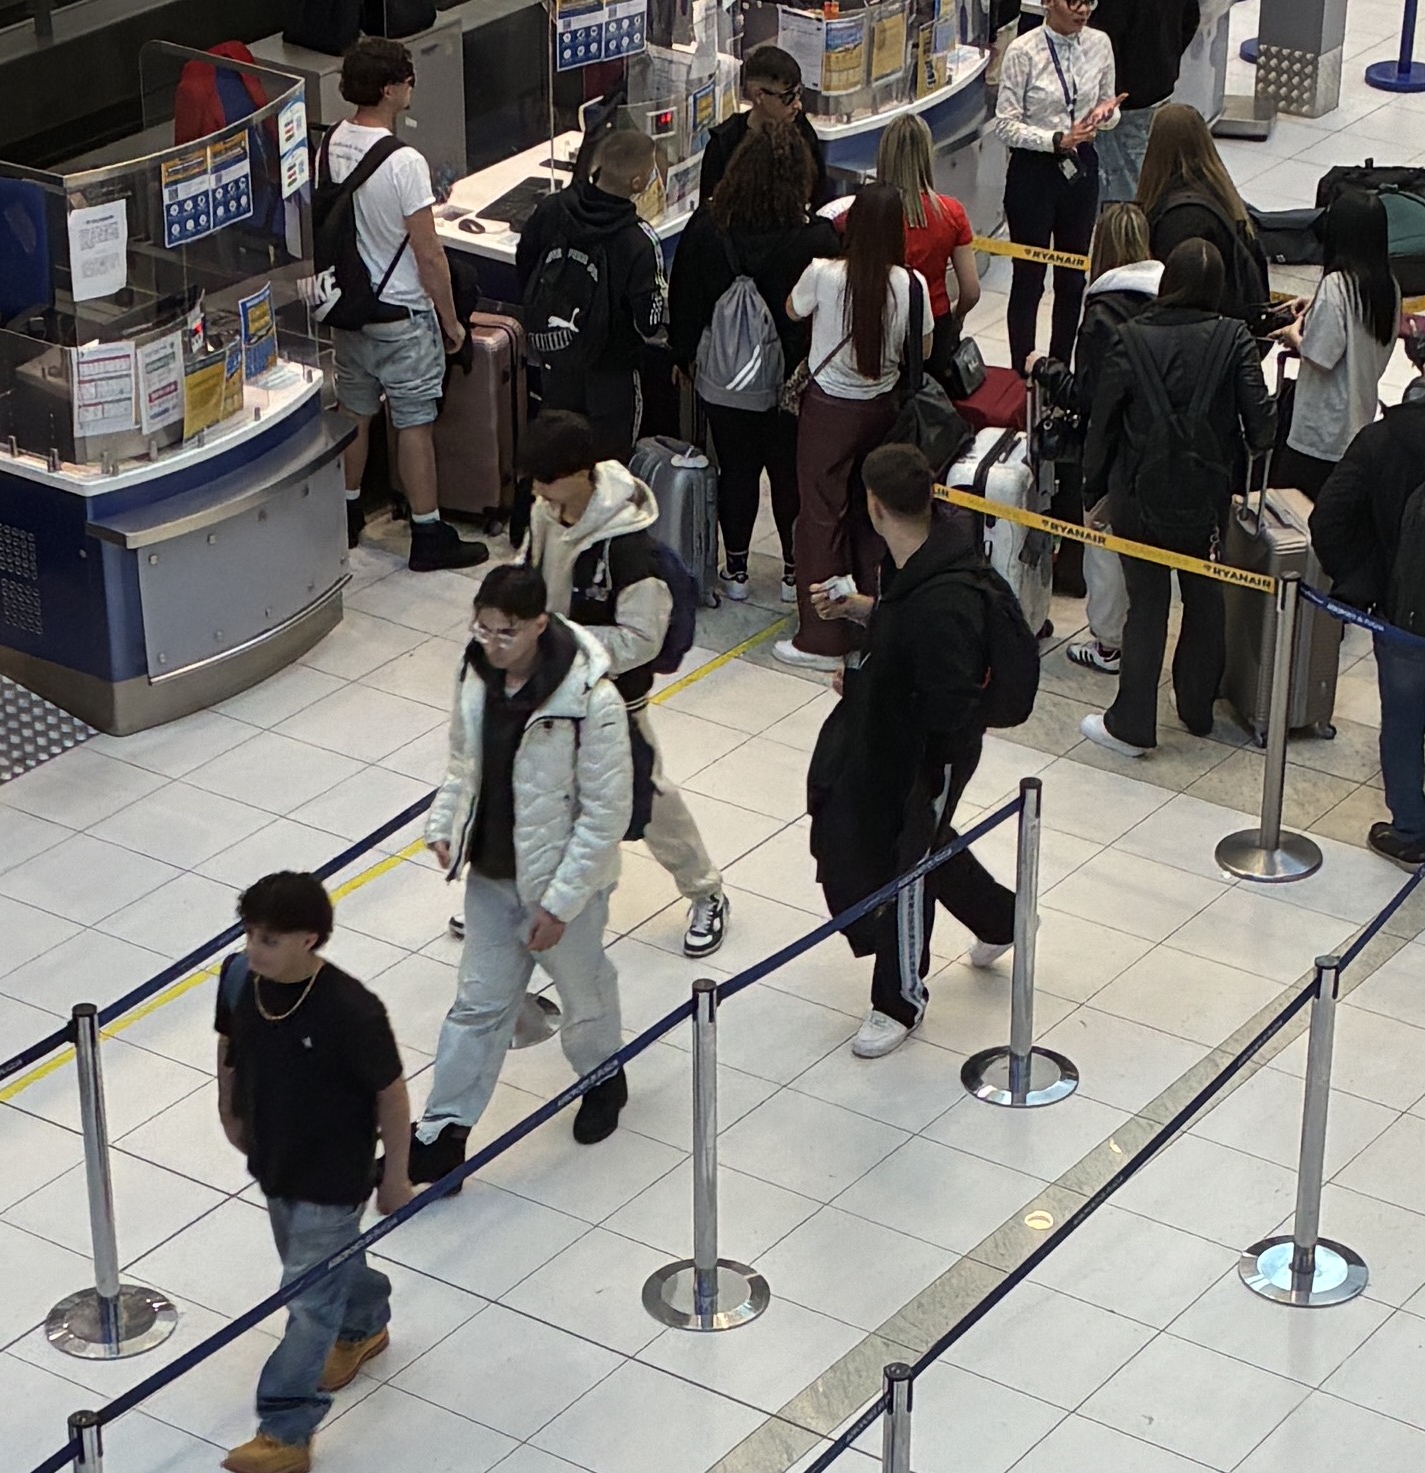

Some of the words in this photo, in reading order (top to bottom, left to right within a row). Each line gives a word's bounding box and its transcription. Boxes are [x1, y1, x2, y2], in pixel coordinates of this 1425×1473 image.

[1032, 250, 1085, 267] RYANAIR
[1050, 521, 1107, 547] RYANAIR
[1212, 566, 1272, 588] RYANAIR
